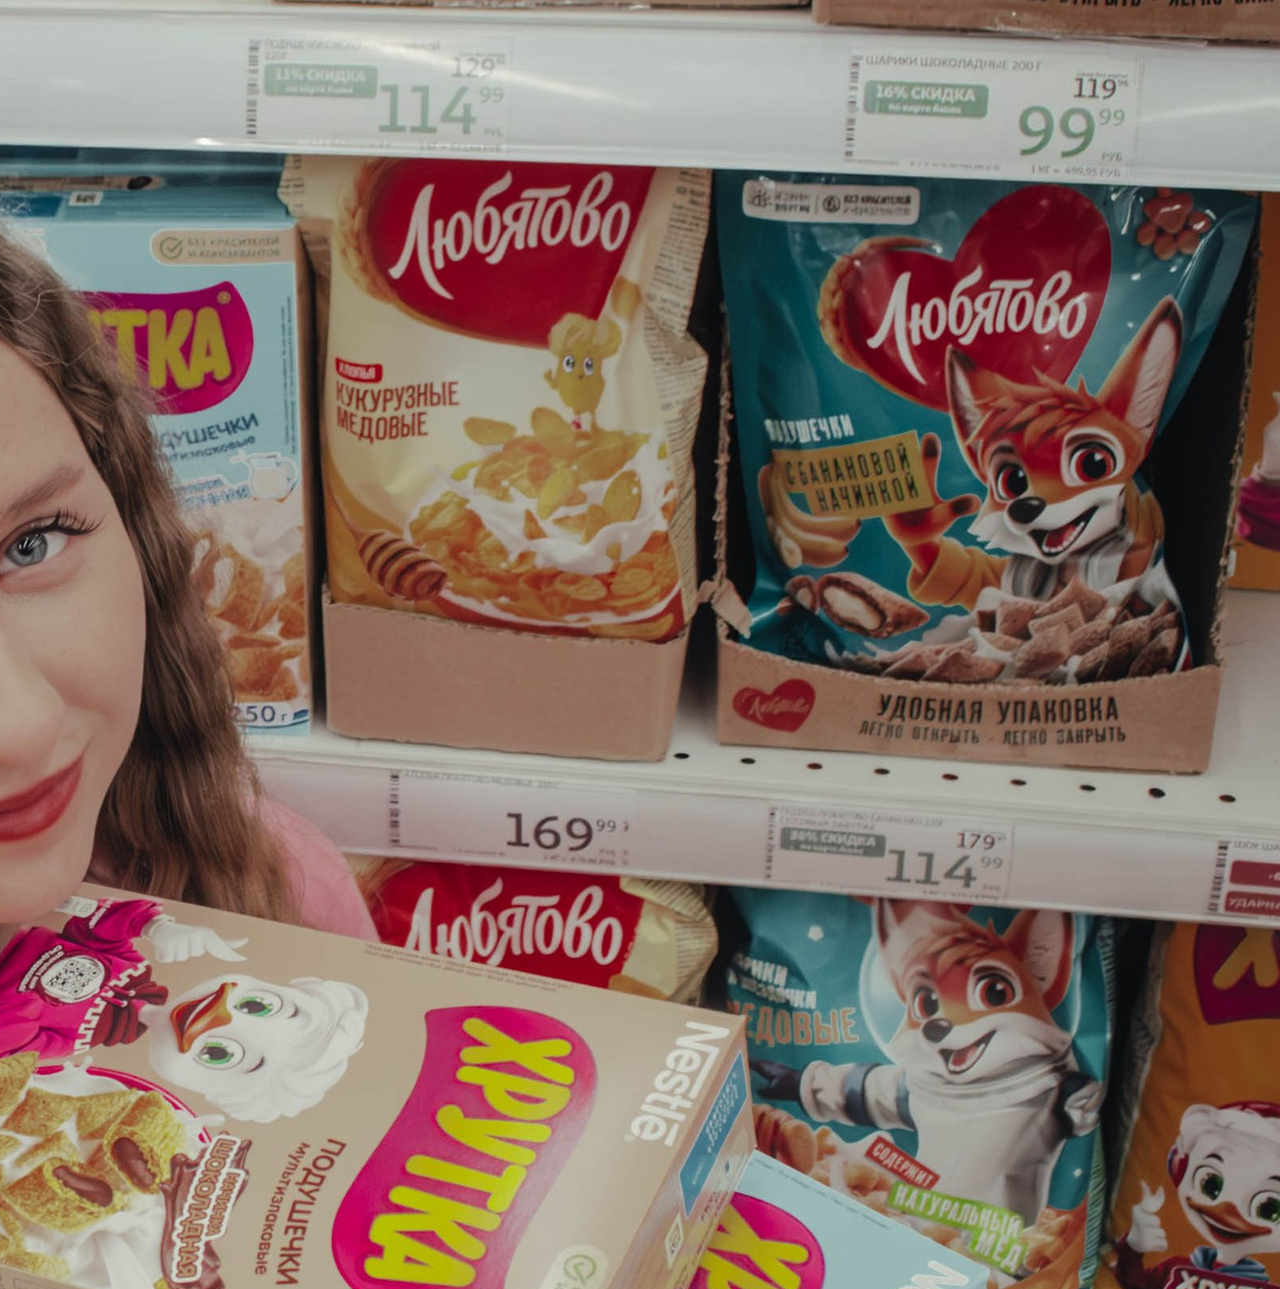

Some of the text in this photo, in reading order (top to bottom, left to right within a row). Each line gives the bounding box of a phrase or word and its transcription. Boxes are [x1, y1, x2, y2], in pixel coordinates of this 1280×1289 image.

[274, 66, 367, 83] 11% СКИДКА
[451, 56, 496, 80] 129
[865, 53, 1010, 72] ШАРИКИ ШОКОЛАДНЫЕ
[876, 85, 976, 103] 16% СКИДКА
[1072, 75, 1117, 101] 119
[378, 83, 505, 135] 114 99
[1018, 104, 1126, 159] 99 99
[389, 170, 631, 300] Любятово
[867, 264, 1088, 386] Любятово
[335, 379, 460, 415] КУКУРУЗНЫЕ
[335, 411, 428, 443] МЕДОВЫЕ
[798, 442, 911, 485] БАНАНОВОЙ
[816, 476, 919, 514] НАЧИНКОЙ
[876, 693, 1119, 723] УДОБНАЯ УПАКОВКА
[859, 720, 1127, 746] ЛЕГКО ОТКРЫТЬ ЛЕГКО ЗАКРЫТЬ
[505, 812, 617, 852] 169 99
[821, 833, 877, 848] СКИДКА
[956, 831, 996, 851] 179
[886, 848, 1004, 888] 114 99
[364, 1016, 576, 1288] ХРУТКА
[872, 1140, 934, 1190] СОДЕРЖИТ
[175, 1137, 238, 1281] ШОКОЛАДНАЯ
[207, 1173, 242, 1238] НАЧИНКА
[253, 1142, 311, 1277] мультизлаковые
[275, 1138, 346, 1287] ПОДУШЕЧКИ
[894, 1184, 1022, 1240] НАТУРАЛЬНЫЙ
